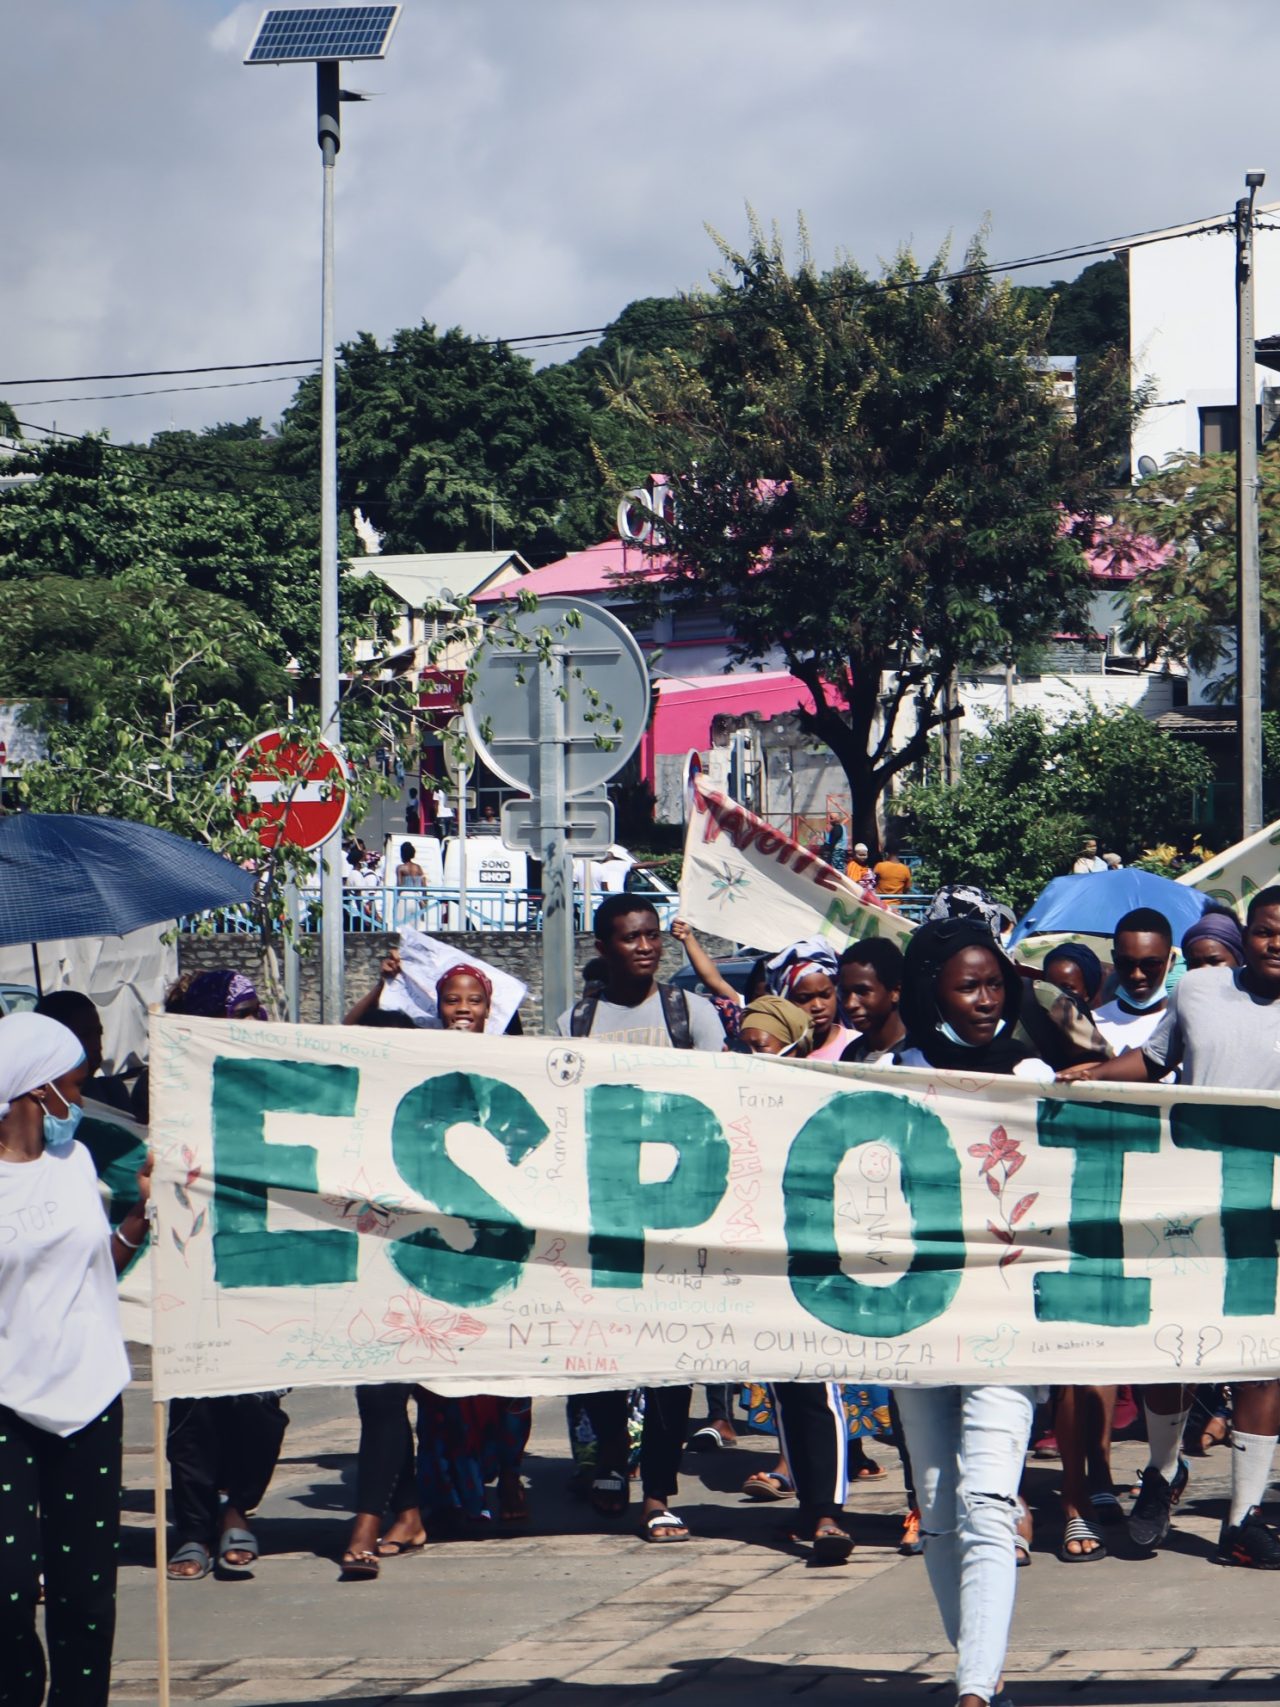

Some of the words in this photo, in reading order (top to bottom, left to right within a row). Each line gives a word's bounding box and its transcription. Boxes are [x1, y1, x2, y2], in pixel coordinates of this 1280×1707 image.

[481, 860, 511, 869] SONO
[480, 872, 511, 882] SHOP
[508, 1319, 608, 1350] NIYA
[634, 1320, 737, 1351] MOJA
